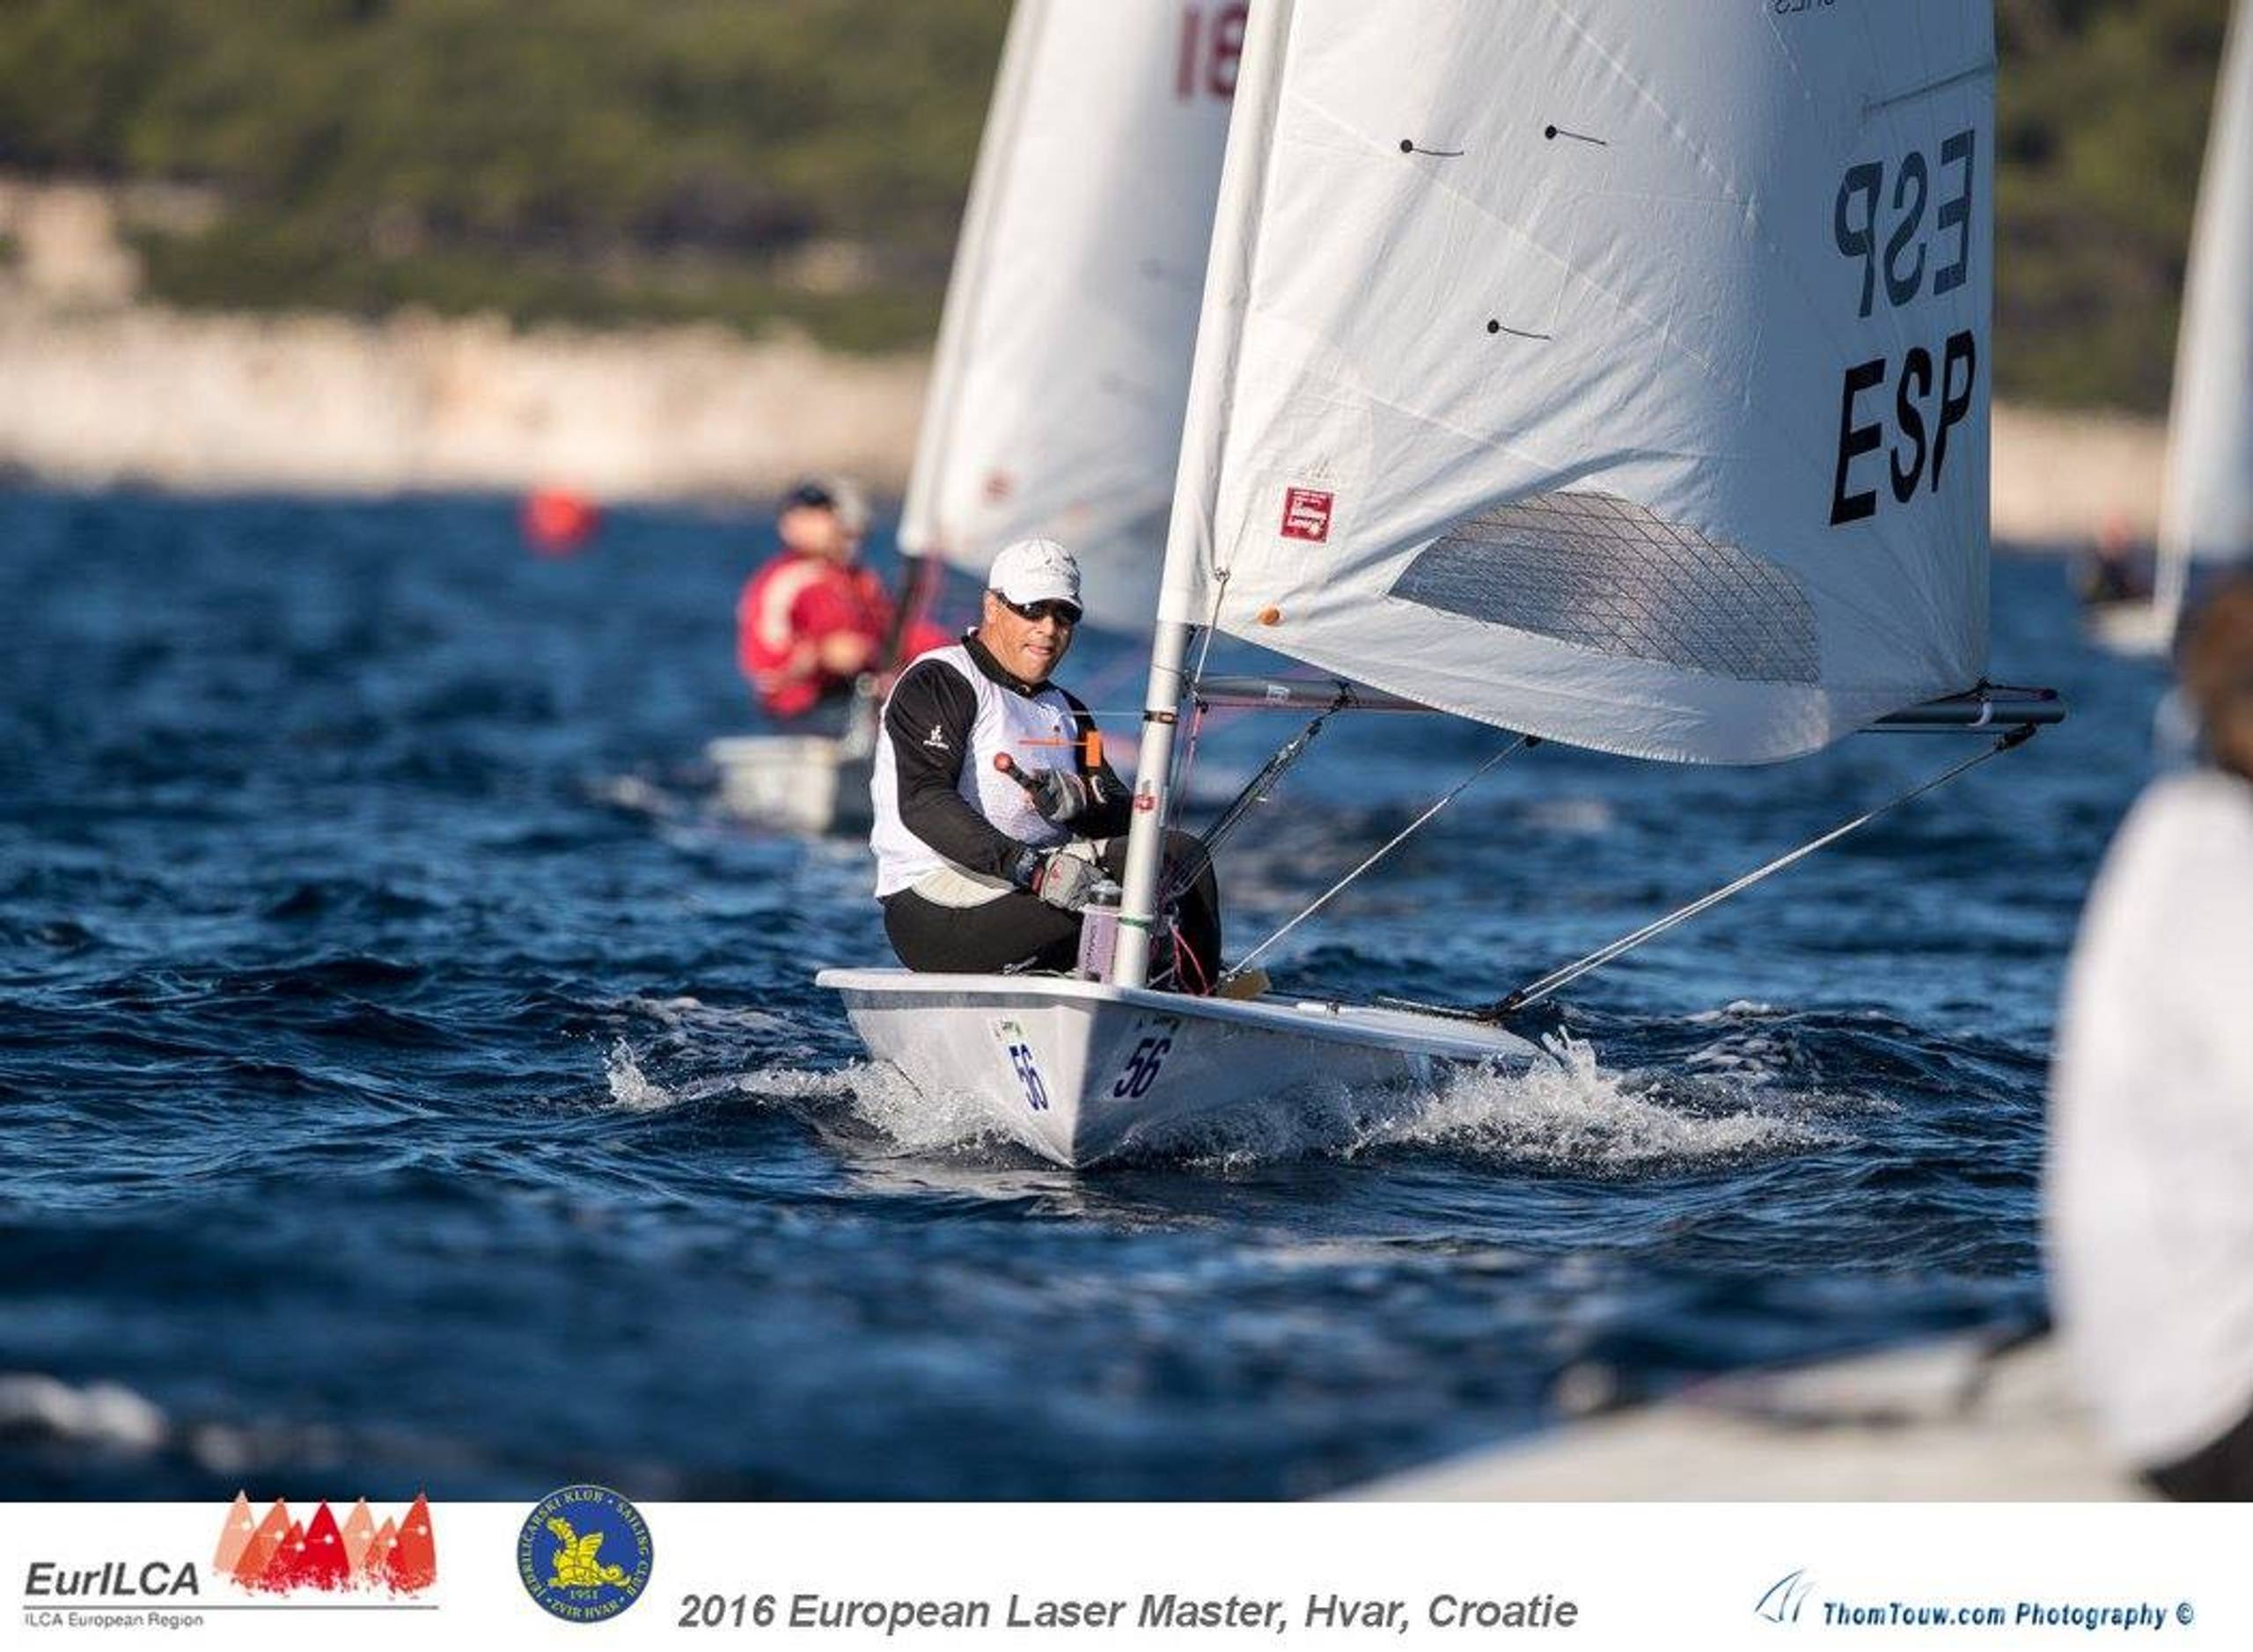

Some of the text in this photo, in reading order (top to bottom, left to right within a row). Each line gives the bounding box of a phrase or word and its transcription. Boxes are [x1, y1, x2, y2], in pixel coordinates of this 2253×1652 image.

[1831, 328, 1977, 526] ESP
[1008, 1043, 1049, 1112] 56
[1112, 1037, 1172, 1099] 56
